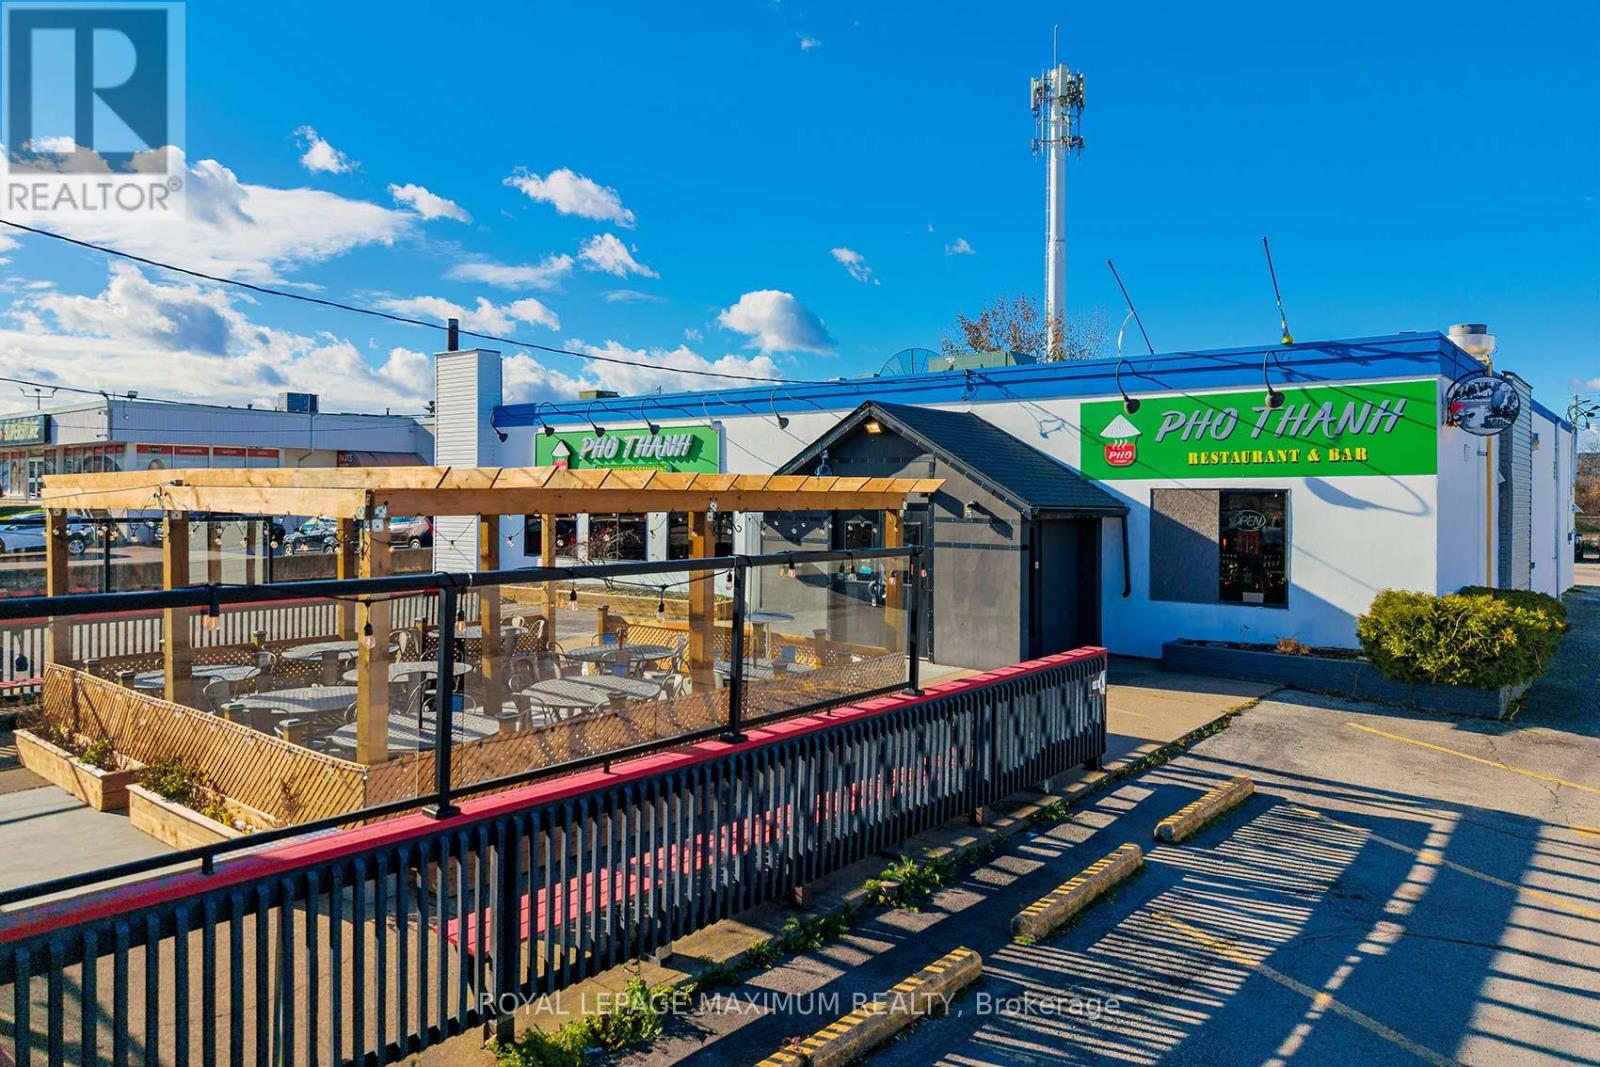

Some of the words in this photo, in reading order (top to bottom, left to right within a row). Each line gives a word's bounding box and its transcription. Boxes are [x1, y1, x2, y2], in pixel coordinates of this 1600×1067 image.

[1155, 407, 1239, 442] PHO
[1251, 398, 1408, 439] THANH
[579, 435, 619, 460] PHO
[623, 432, 692, 460] THANH
[1108, 450, 1133, 460] PHO
[1188, 449, 1300, 465] RESTAURANT
[1307, 450, 1321, 462] &
[1328, 447, 1368, 462] BAR
